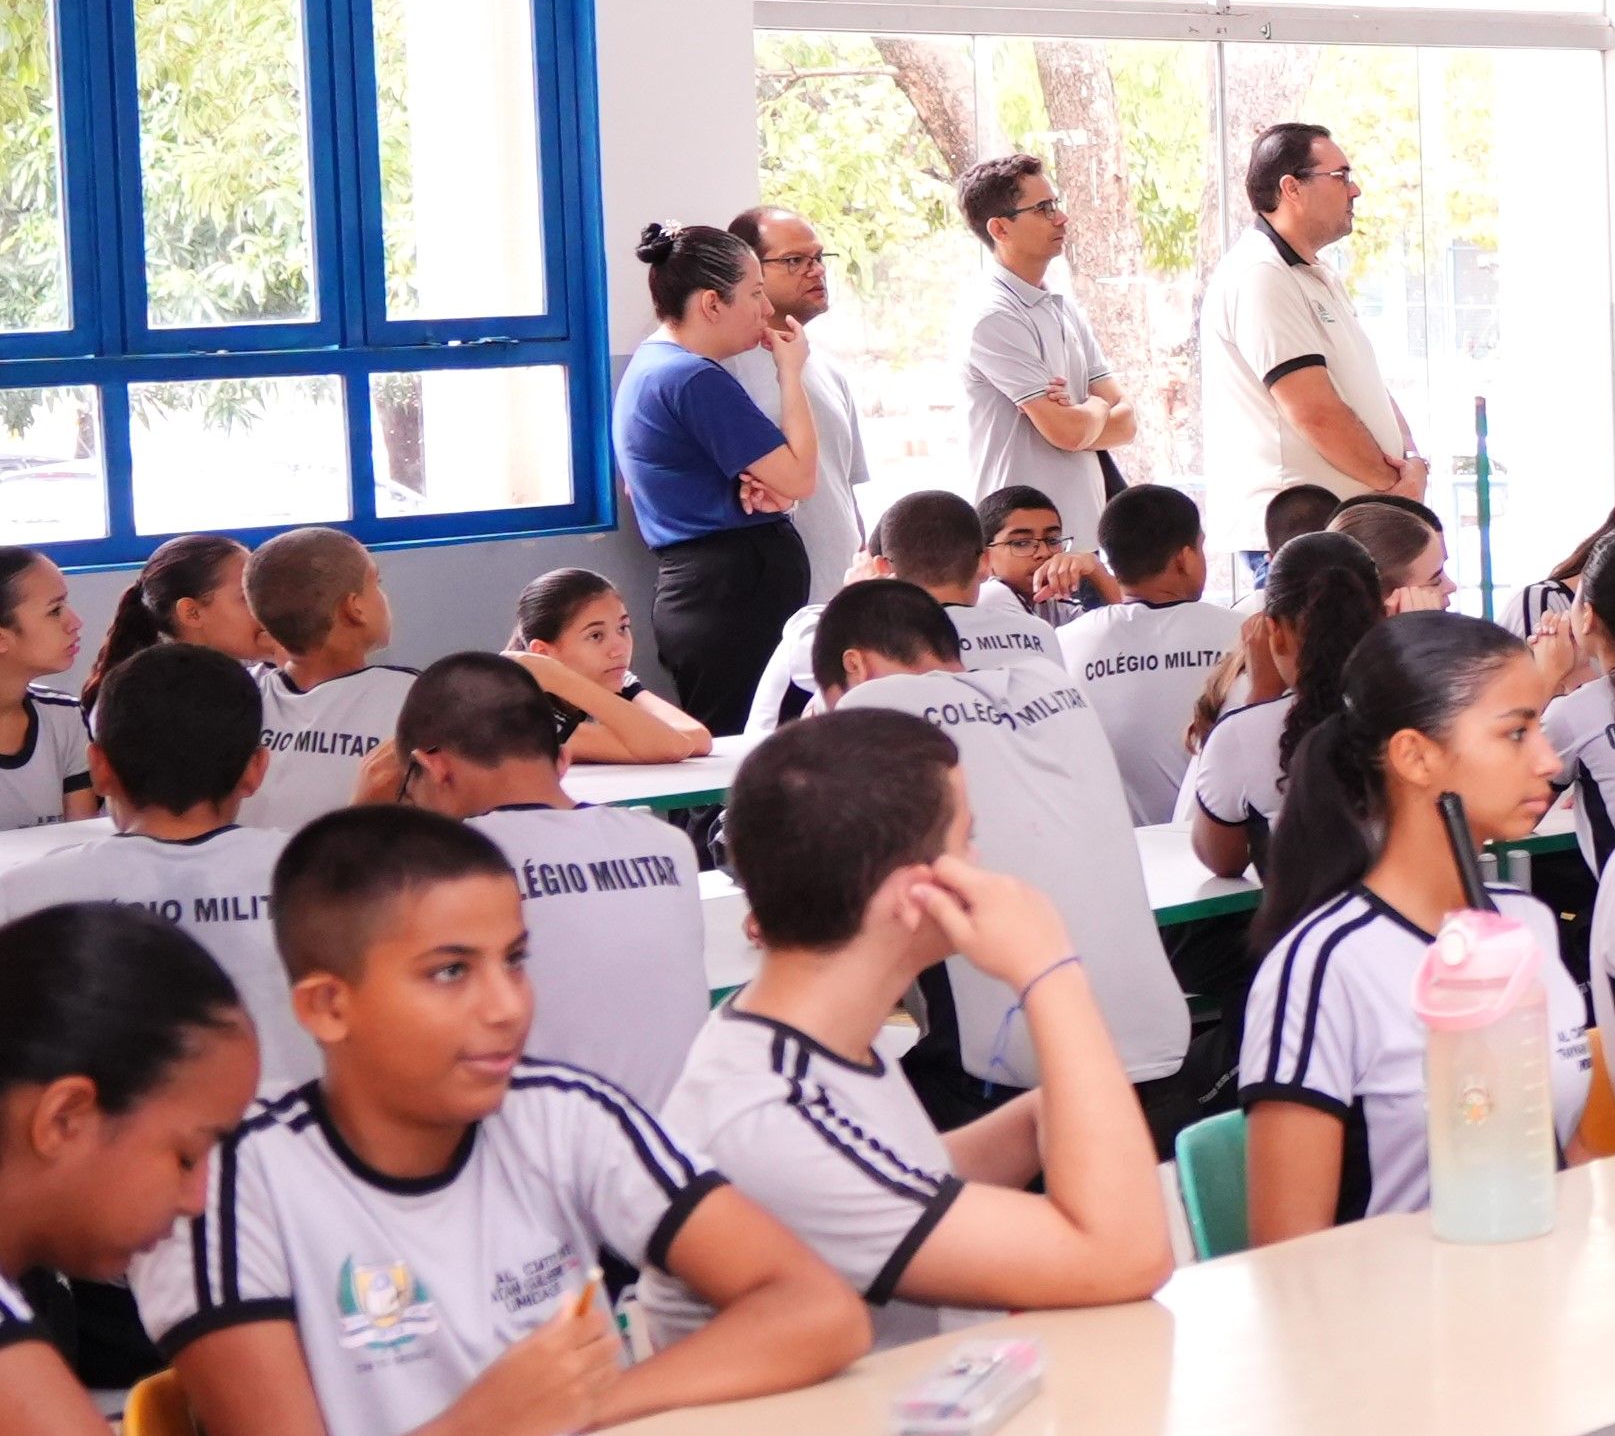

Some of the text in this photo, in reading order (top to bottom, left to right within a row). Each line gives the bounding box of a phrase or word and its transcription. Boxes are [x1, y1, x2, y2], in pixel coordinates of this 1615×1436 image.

[976, 633, 1044, 653] MILITAR
[1085, 652, 1159, 681] COLÉGIO
[587, 855, 681, 893] MILITAR
